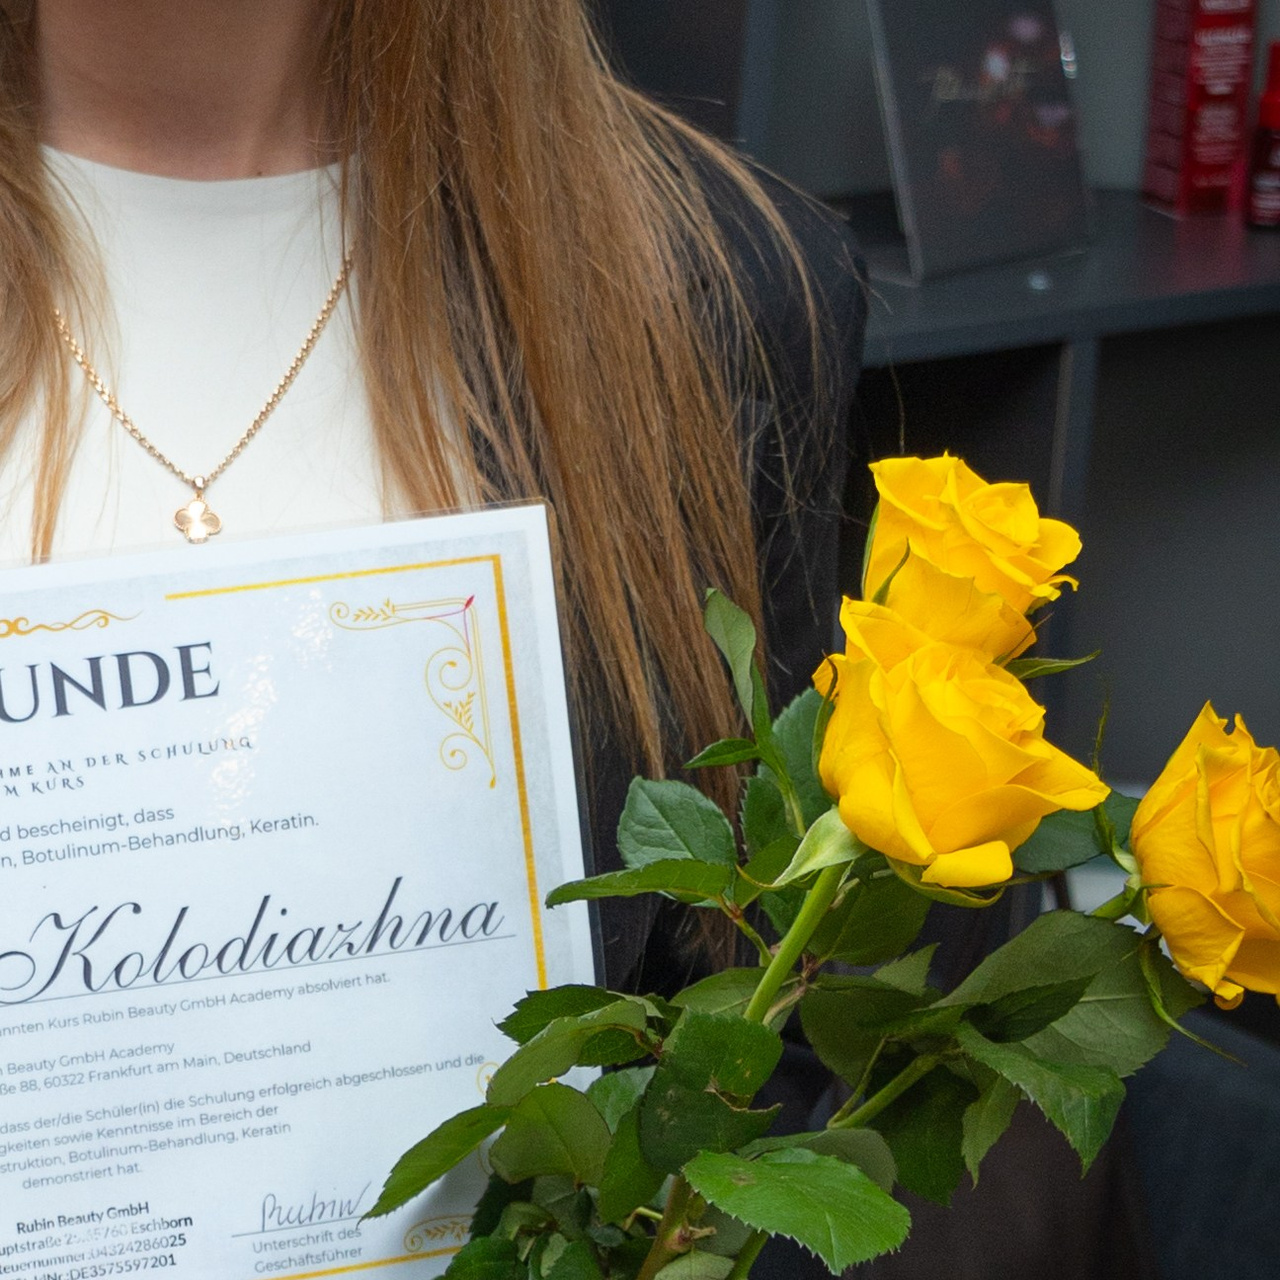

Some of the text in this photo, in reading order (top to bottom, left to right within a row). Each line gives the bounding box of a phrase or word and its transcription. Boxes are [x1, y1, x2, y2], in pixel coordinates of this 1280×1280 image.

[47, 759, 75, 774] AN
[84, 752, 129, 768] DER
[137, 736, 253, 762] SCHULUNG
[31, 775, 85, 794] KURS
[16, 812, 129, 840] bescheinigt,
[133, 807, 175, 824] dass
[21, 825, 245, 865] Botulinum-Behandlung,
[249, 812, 319, 834] Keratin.
[47, 1016, 80, 1029] Kurs
[81, 1009, 125, 1025] Rubin
[127, 1002, 177, 1019] Beauty
[179, 993, 227, 1012] GmbH
[228, 986, 294, 1005] Academy
[297, 976, 362, 995] absolviert
[364, 972, 391, 985] hat.
[6, 1058, 56, 1075] Beauty
[58, 1049, 105, 1067] GmbH
[108, 1042, 175, 1060] Academy
[19, 1079, 41, 1093] 88,
[42, 1071, 84, 1089] 60322
[87, 1063, 154, 1082] Frankfurt
[156, 1061, 179, 1073] am
[182, 1054, 221, 1069] Main,
[223, 1039, 312, 1064] Deutschland
[33, 1111, 83, 1129] der/die
[85, 1100, 160, 1122] Schüler(in)
[163, 1097, 185, 1111] die
[187, 1089, 256, 1108] Schulung
[258, 1076, 332, 1098] erfolgreich
[334, 1063, 433, 1087] abgeschlossen
[435, 1055, 462, 1071] und
[464, 1053, 484, 1066] die
[53, 1130, 93, 1146] sowie
[95, 1120, 174, 1140] Kenntnisse
[177, 1116, 196, 1127] im
[198, 1107, 253, 1125] Bereich
[255, 1104, 279, 1118] der
[67, 1130, 239, 1164] Botulinum-Behandlung,
[241, 1122, 292, 1139] Keratin
[21, 1162, 143, 1190] demonstriert hat.
[16, 1200, 150, 1235] Rubin Beauty GmbH
[130, 1215, 194, 1235] Eschborn
[252, 1226, 363, 1254] Unterschrift des
[253, 1247, 362, 1274] Geschäftsführer
